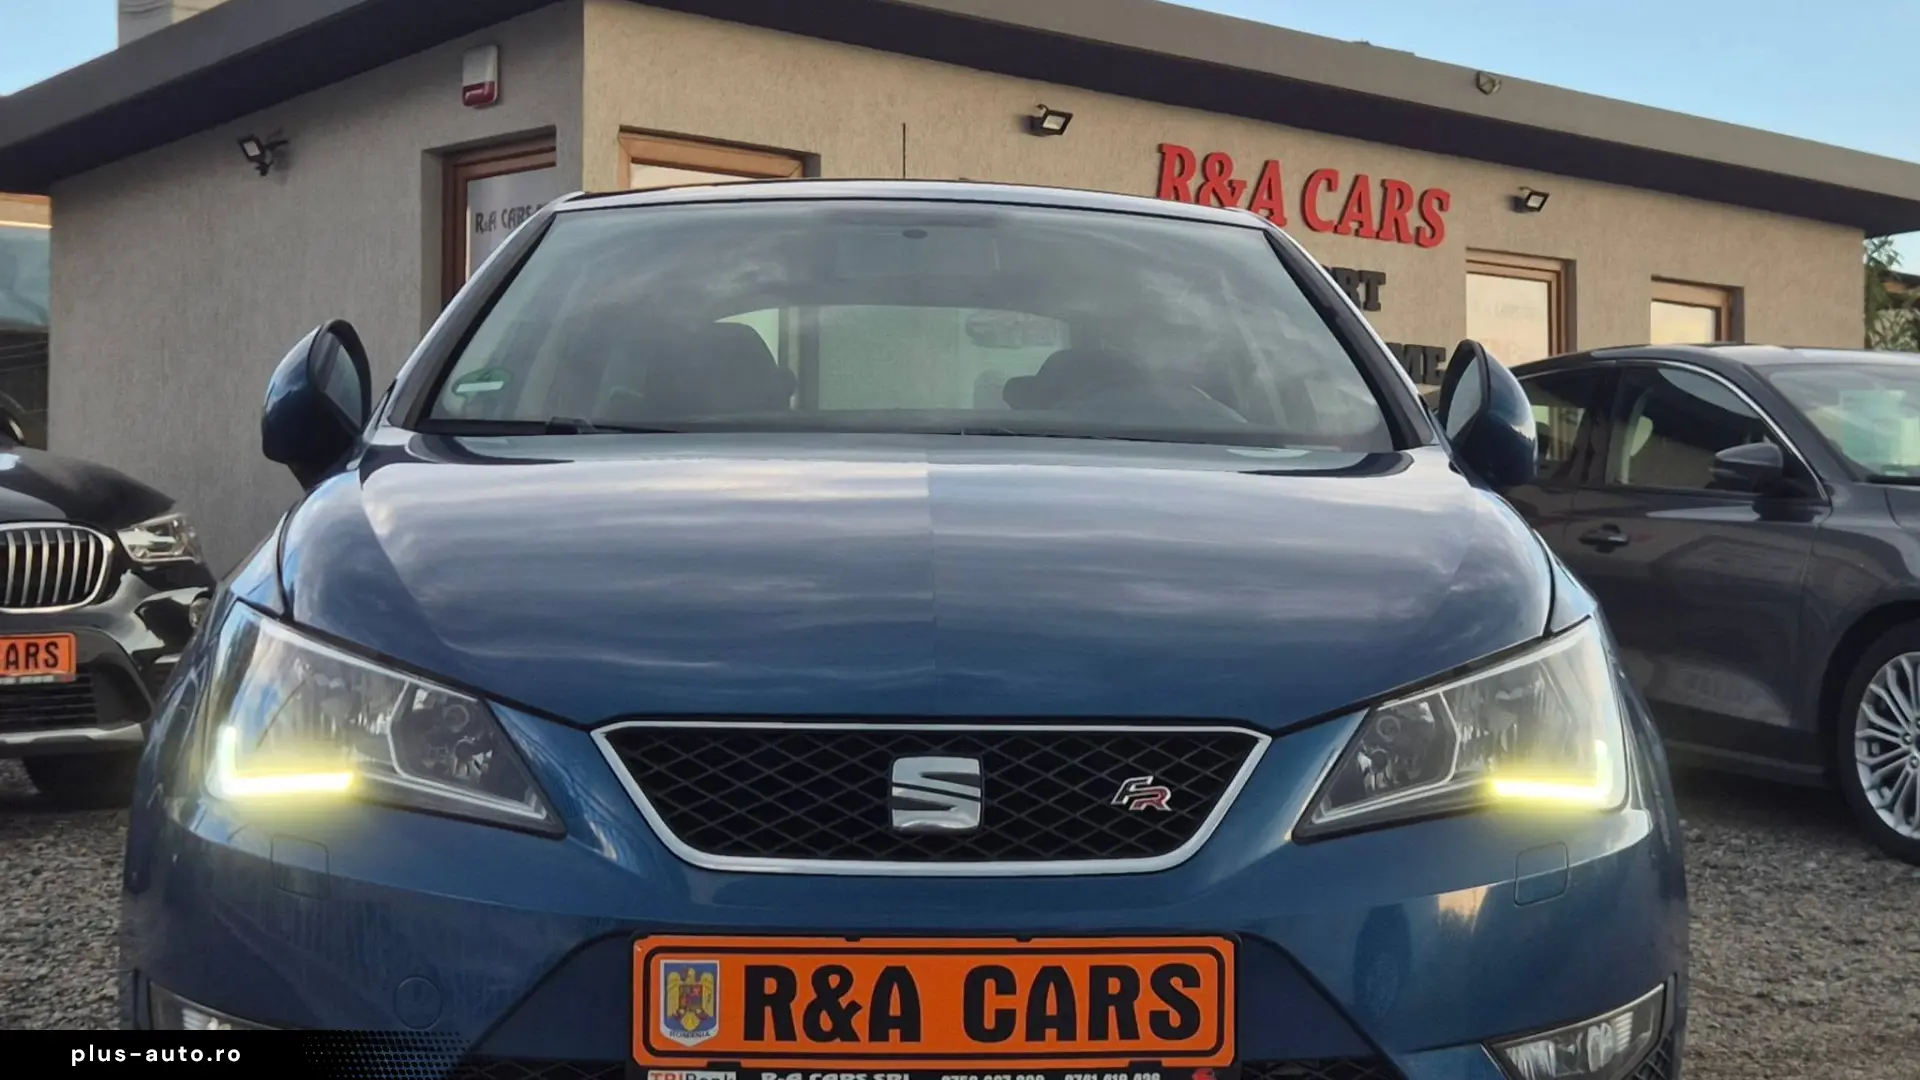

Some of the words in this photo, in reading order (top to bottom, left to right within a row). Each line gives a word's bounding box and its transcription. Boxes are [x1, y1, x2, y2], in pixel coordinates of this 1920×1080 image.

[1157, 143, 1287, 227] R&A
[1303, 168, 1451, 248] CARS
[1321, 264, 1386, 312] RT
[5, 641, 59, 670] ARS
[1110, 775, 1172, 811] FR
[743, 964, 922, 1043] R&A
[963, 962, 1202, 1043] CARS
